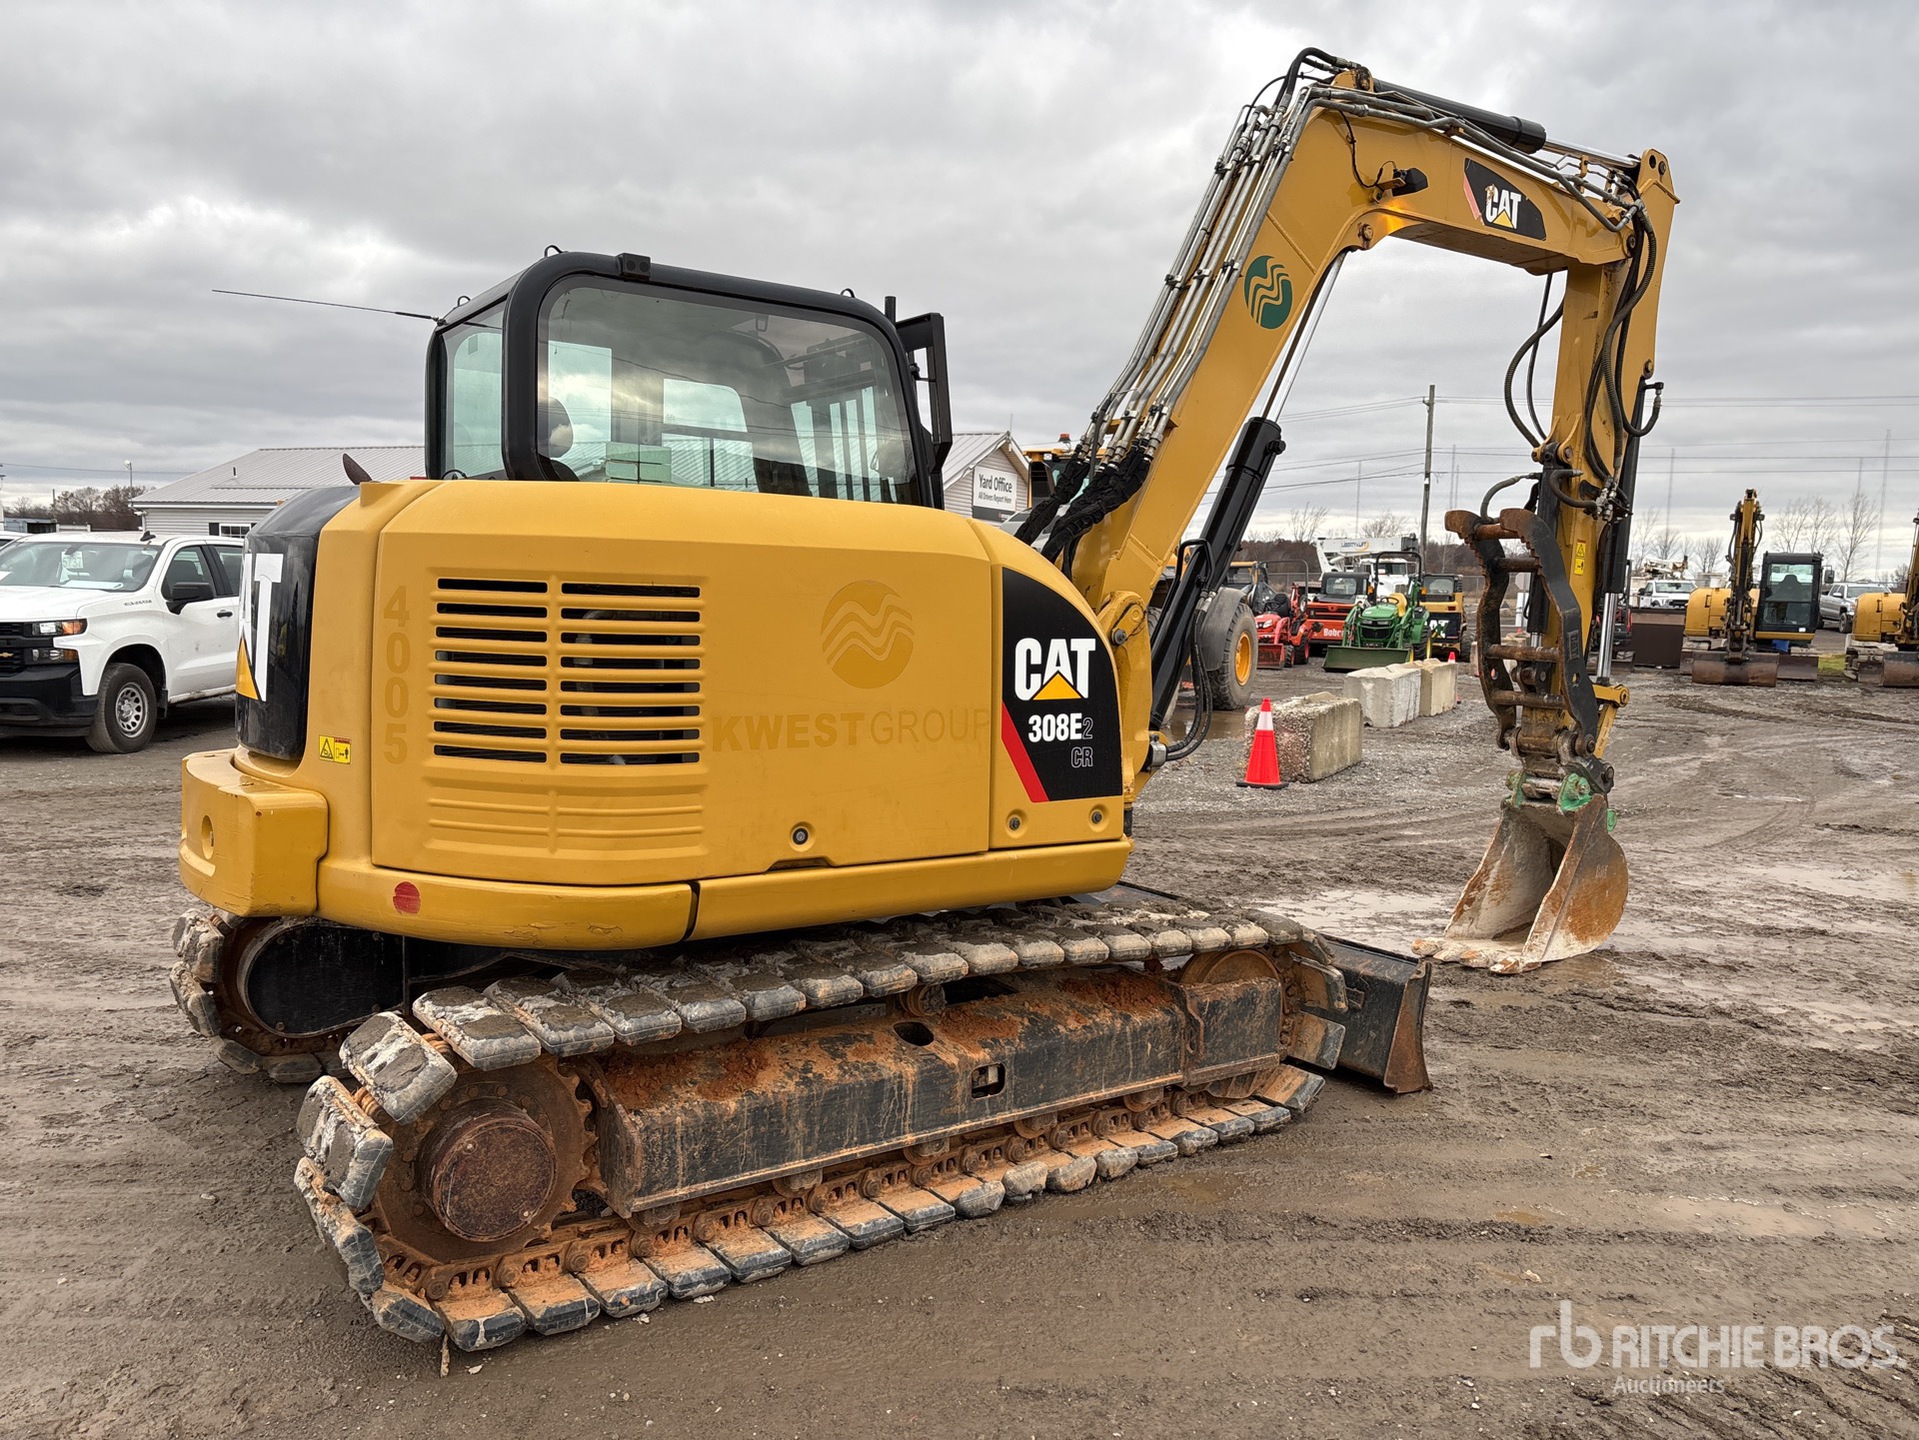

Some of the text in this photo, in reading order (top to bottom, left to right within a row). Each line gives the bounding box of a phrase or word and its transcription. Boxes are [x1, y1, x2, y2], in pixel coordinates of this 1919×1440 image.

[1485, 184, 1521, 229] CAT
[979, 474, 1012, 493] Yard Office
[239, 553, 284, 702] AT
[1323, 628, 1346, 638] Bobc
[1424, 619, 1450, 639] AT
[384, 584, 411, 765] 4005
[1014, 637, 1097, 701] CAT
[1028, 712, 1094, 743] 308E2
[1070, 746, 1094, 769] CR
